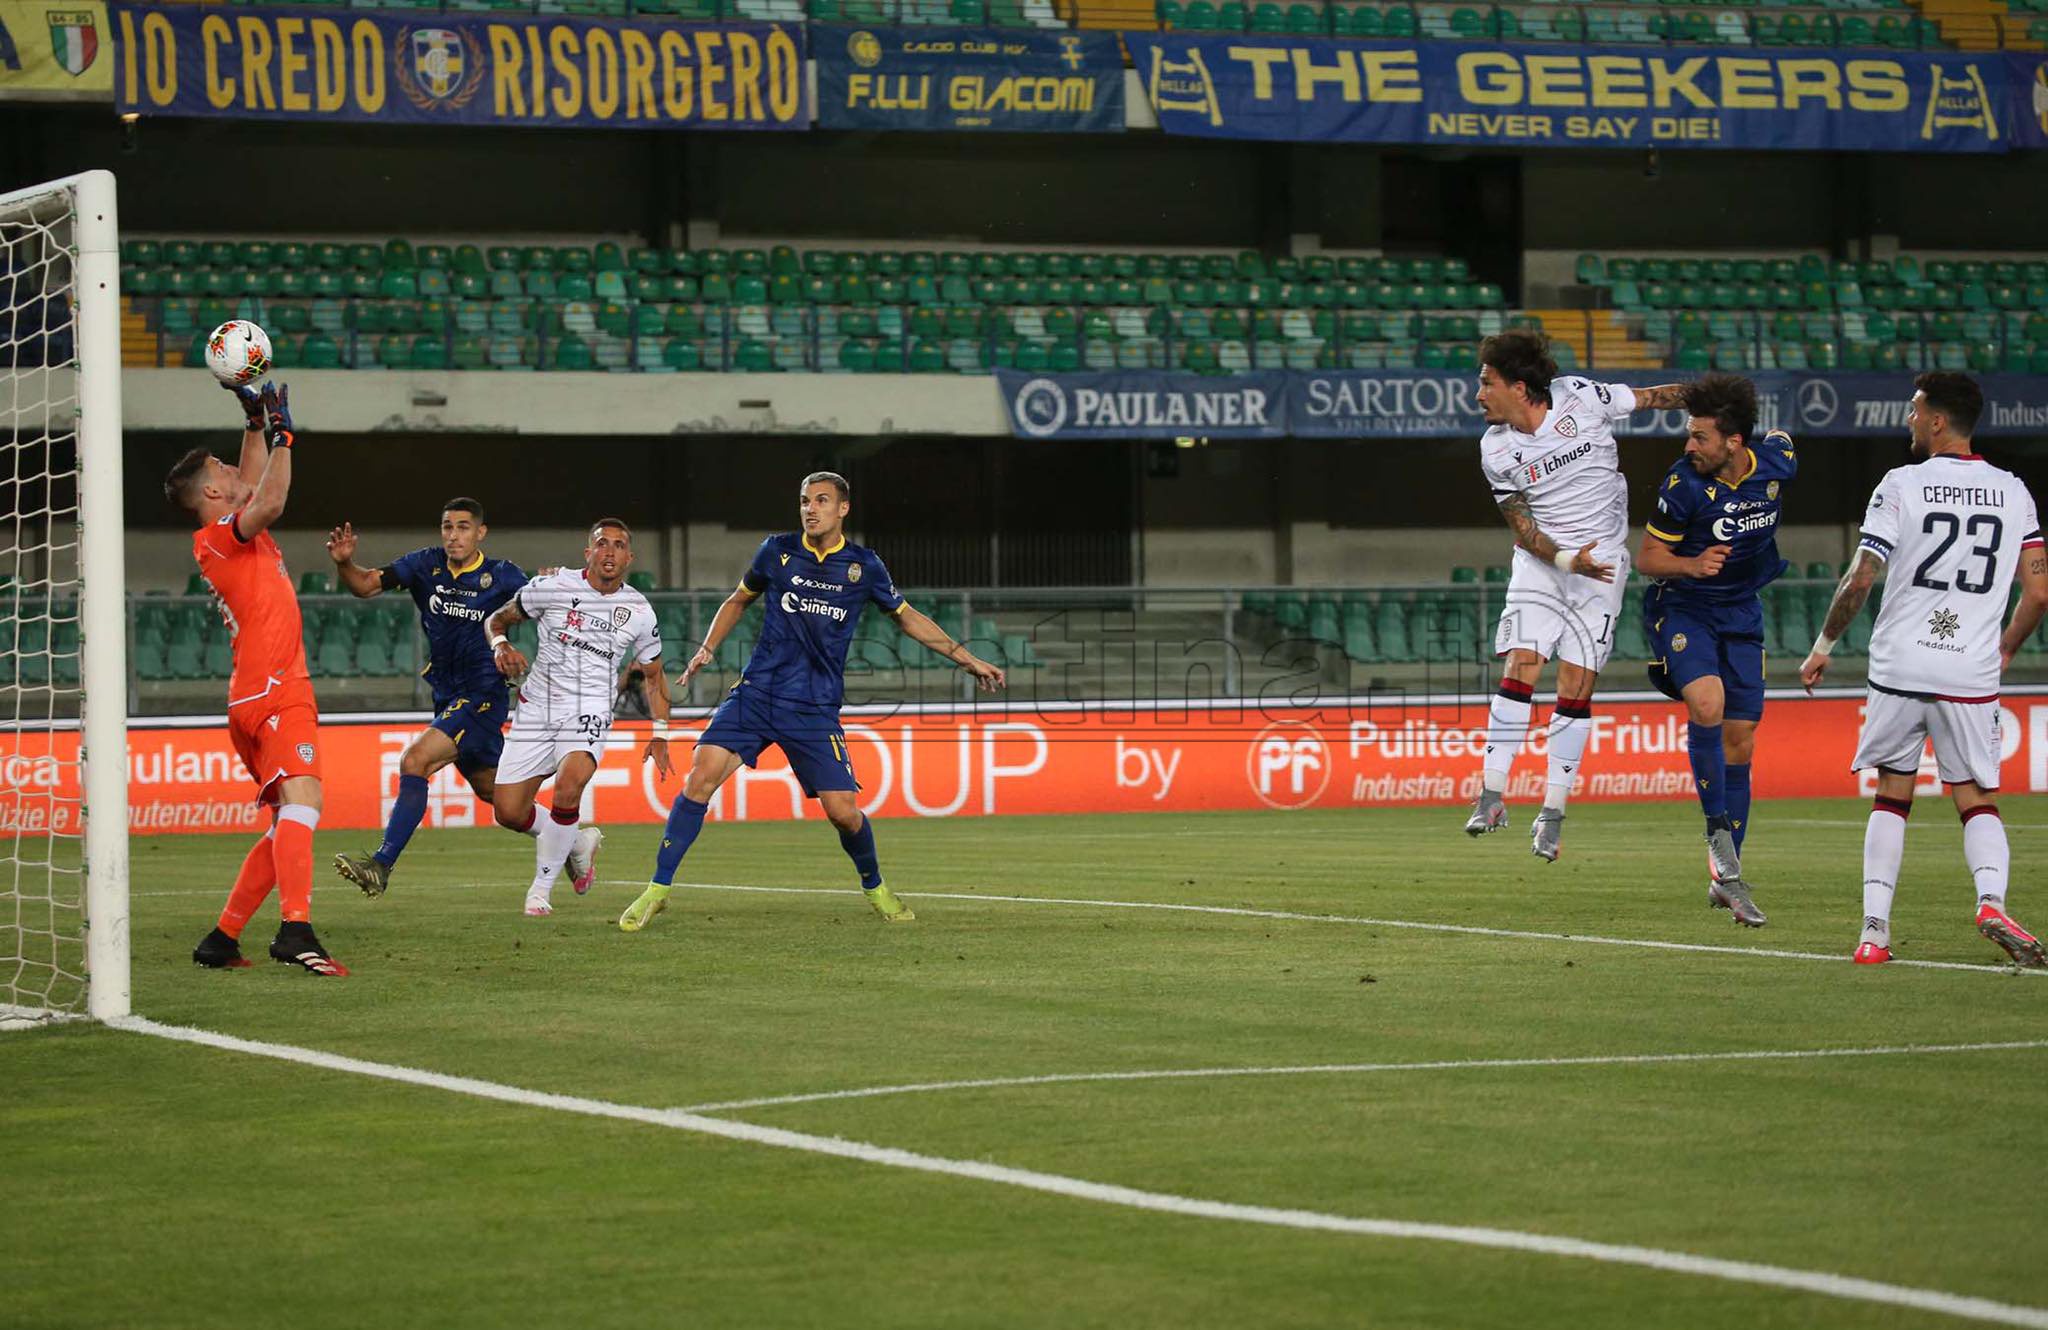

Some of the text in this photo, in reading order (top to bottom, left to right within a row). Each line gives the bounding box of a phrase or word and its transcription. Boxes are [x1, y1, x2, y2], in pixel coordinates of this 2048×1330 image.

[119, 11, 178, 106] IO
[202, 15, 386, 115] CREDO
[488, 24, 799, 122] RISORGERÒ
[1228, 46, 1911, 112] THE GEEKERS
[847, 74, 1095, 112] F.LLI GIACOMI
[1429, 113, 1721, 140] NEVER SAY DIE!
[1074, 389, 1268, 427] PAULANER
[1306, 378, 1484, 416] SARTOR
[1991, 400, 2048, 427] Indus
[1923, 486, 2004, 508] CEPPITELLI
[1912, 512, 2003, 594] 23
[442, 602, 485, 622] Sinergy
[800, 598, 848, 622] Sinergy
[576, 714, 602, 738] 33
[1116, 735, 1182, 801] by
[1353, 771, 1455, 801] Industria
